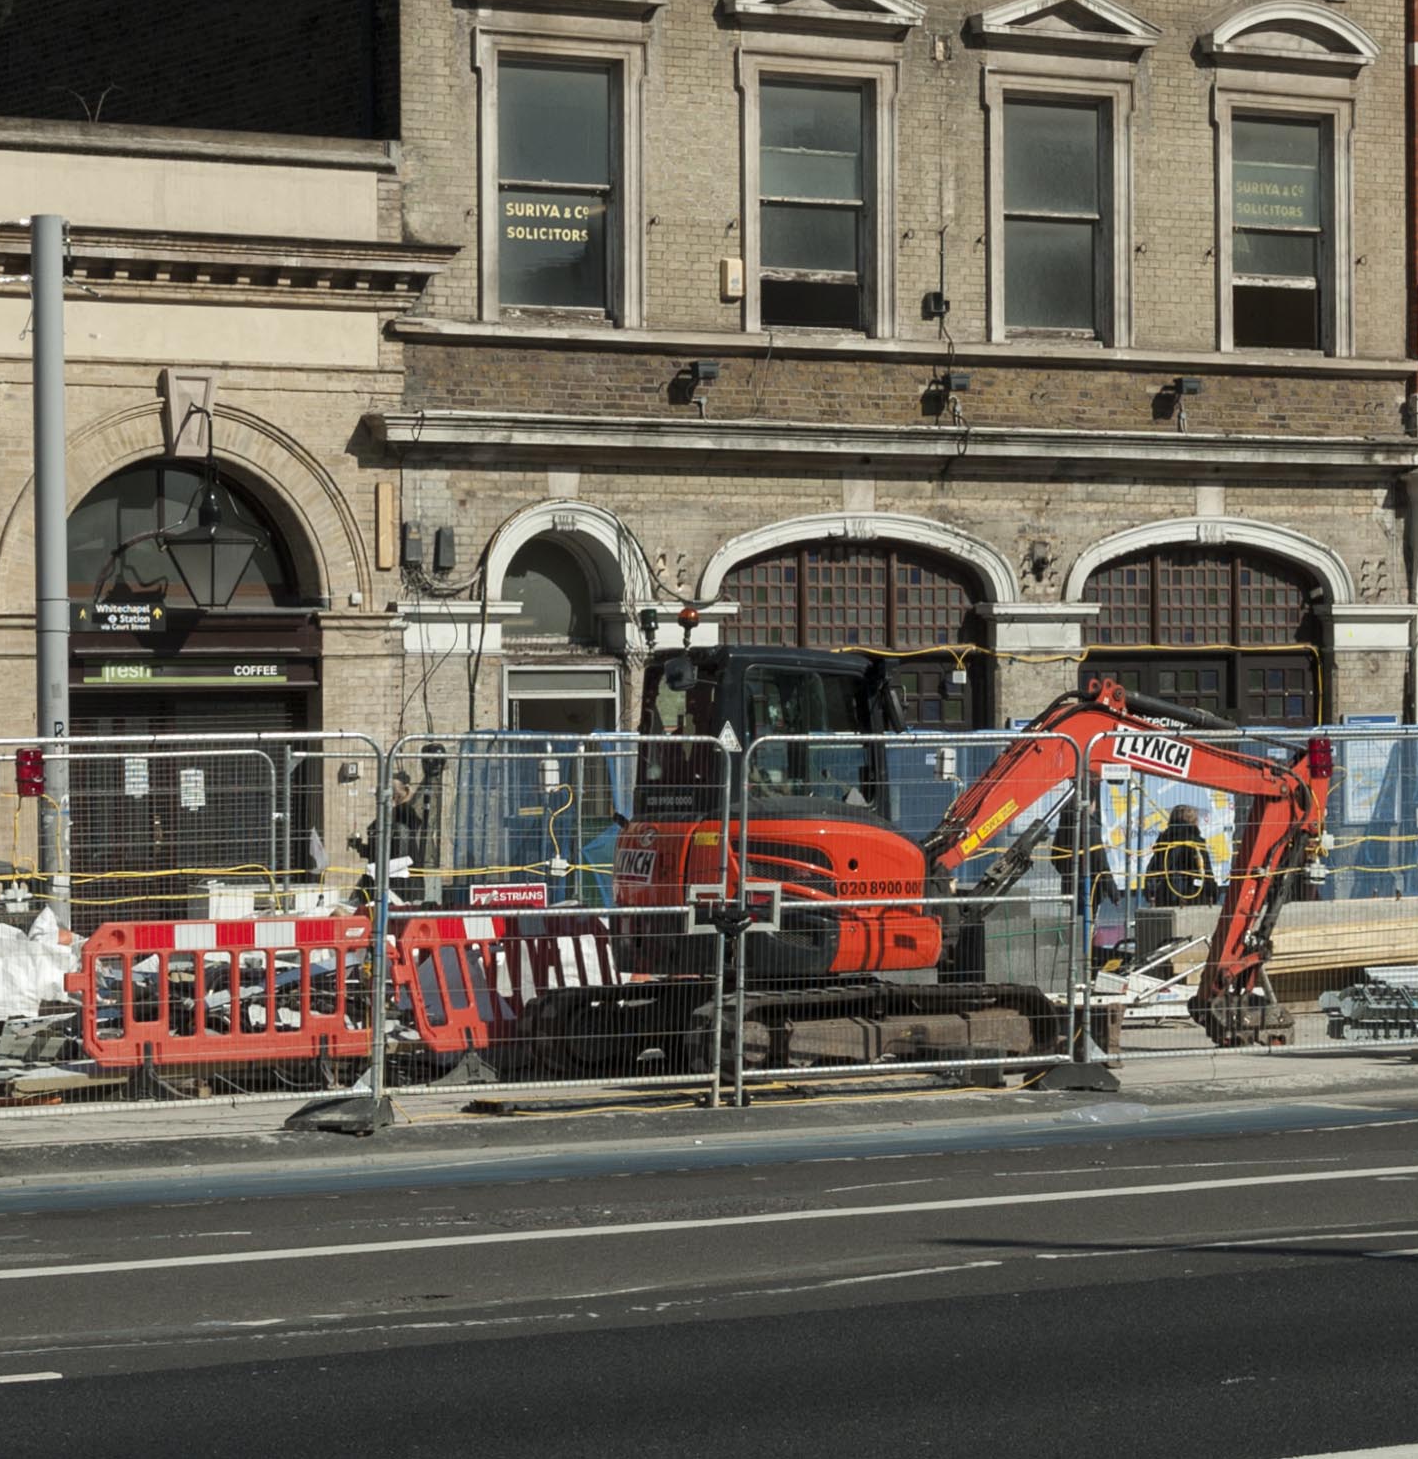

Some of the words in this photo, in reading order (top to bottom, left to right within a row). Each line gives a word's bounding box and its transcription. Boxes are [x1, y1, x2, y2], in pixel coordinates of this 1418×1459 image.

[1236, 180, 1280, 197] SURIYA
[505, 202, 561, 219] SURIYA
[564, 207, 572, 220] &
[1236, 201, 1304, 219] SOLICITORS
[506, 226, 589, 243] SOLICITORS
[95, 604, 151, 616] Whitechapel
[119, 614, 151, 623] Station
[233, 665, 278, 677] COFFEE
[839, 881, 868, 896] 020
[870, 880, 902, 896] 8900
